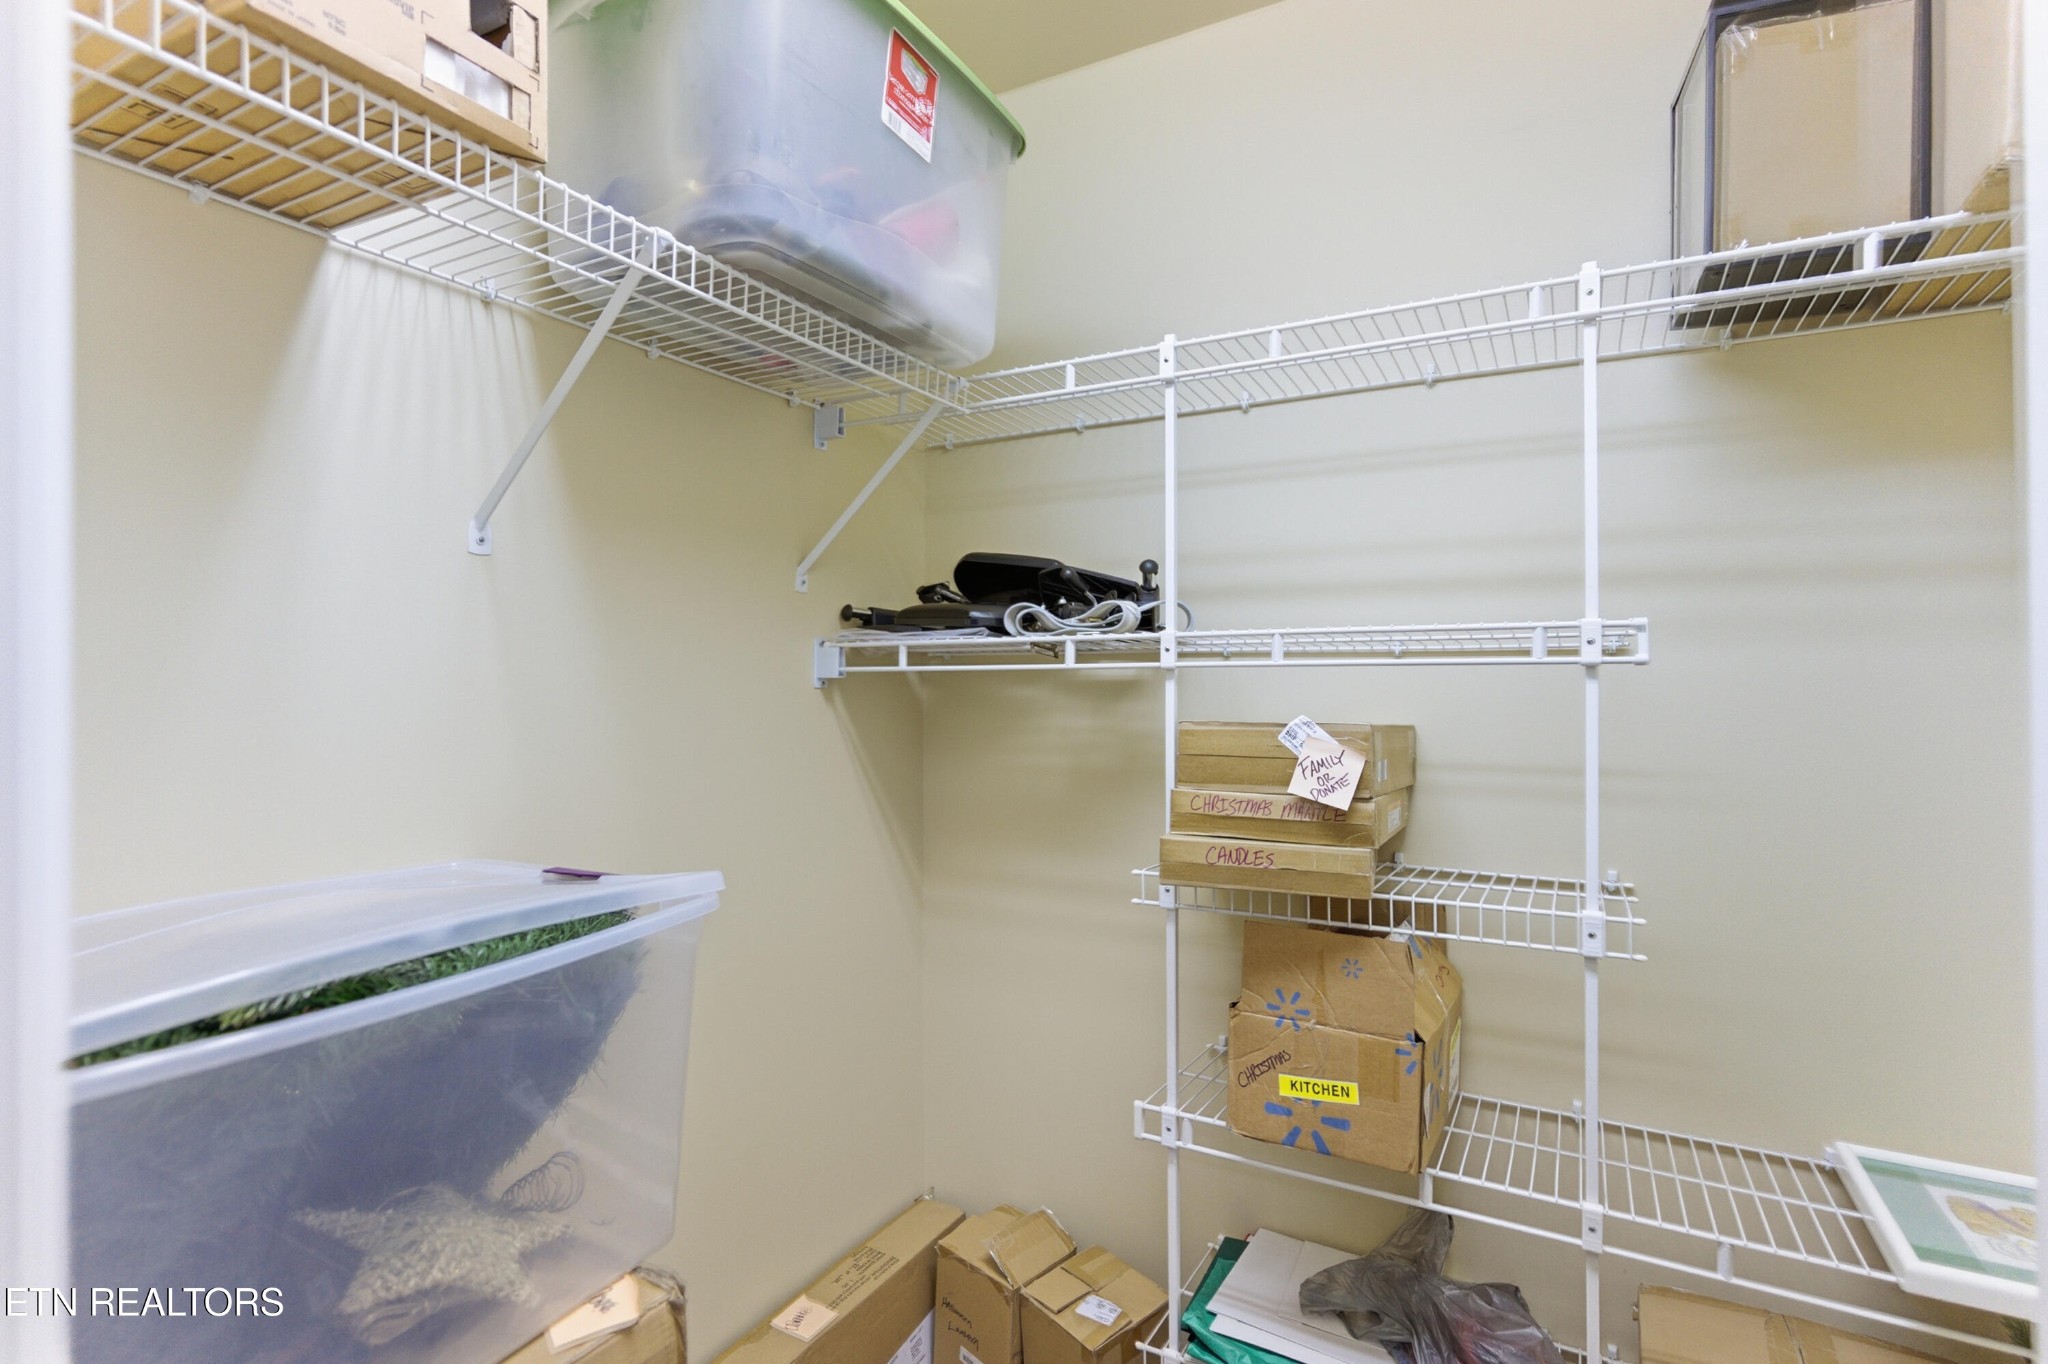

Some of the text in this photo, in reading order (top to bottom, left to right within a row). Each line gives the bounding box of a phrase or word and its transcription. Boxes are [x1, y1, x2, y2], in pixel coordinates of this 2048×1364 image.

[1298, 749, 1345, 780] FAMILY
[1310, 772, 1351, 801] DONATE
[1317, 773, 1335, 787] OR
[1190, 794, 1273, 816] CHRISTMAS
[1205, 845, 1275, 869] CANDLES
[1238, 1049, 1292, 1088] CHRISTMAS
[1290, 1079, 1350, 1098] KITCHEN
